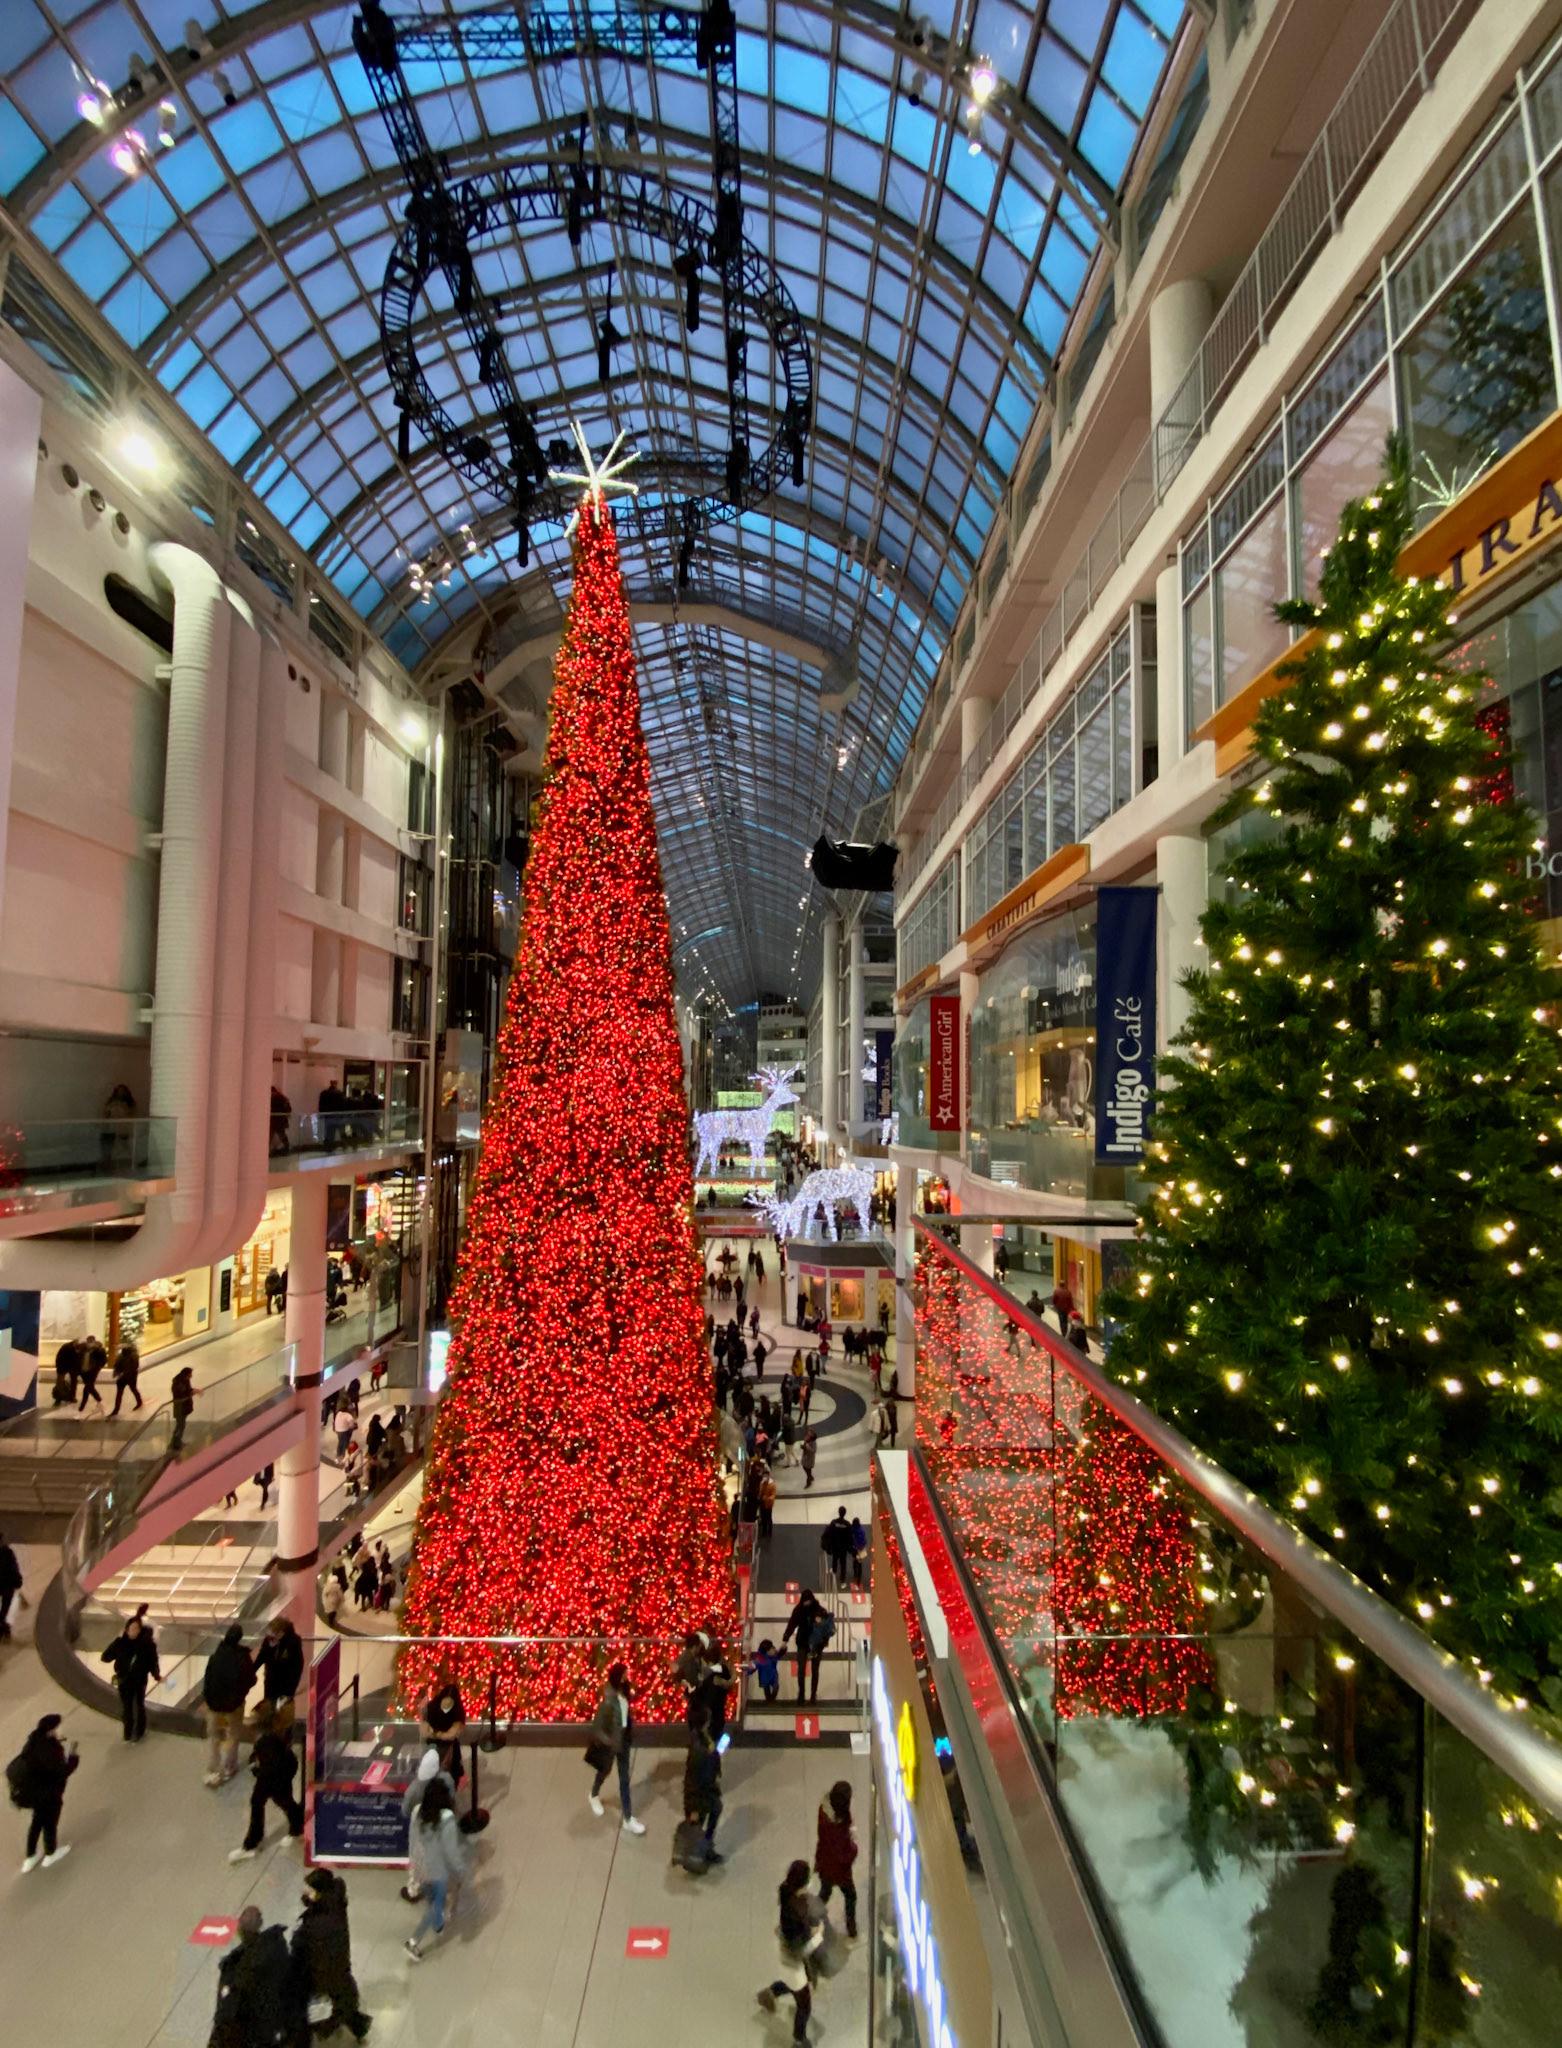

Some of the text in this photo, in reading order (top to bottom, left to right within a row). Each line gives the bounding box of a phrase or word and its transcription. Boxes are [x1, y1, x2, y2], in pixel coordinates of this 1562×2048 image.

[878, 1088, 892, 1116] Indigo
[937, 1008, 953, 1104] American Girl
[1105, 997, 1150, 1152] Indigo Café
